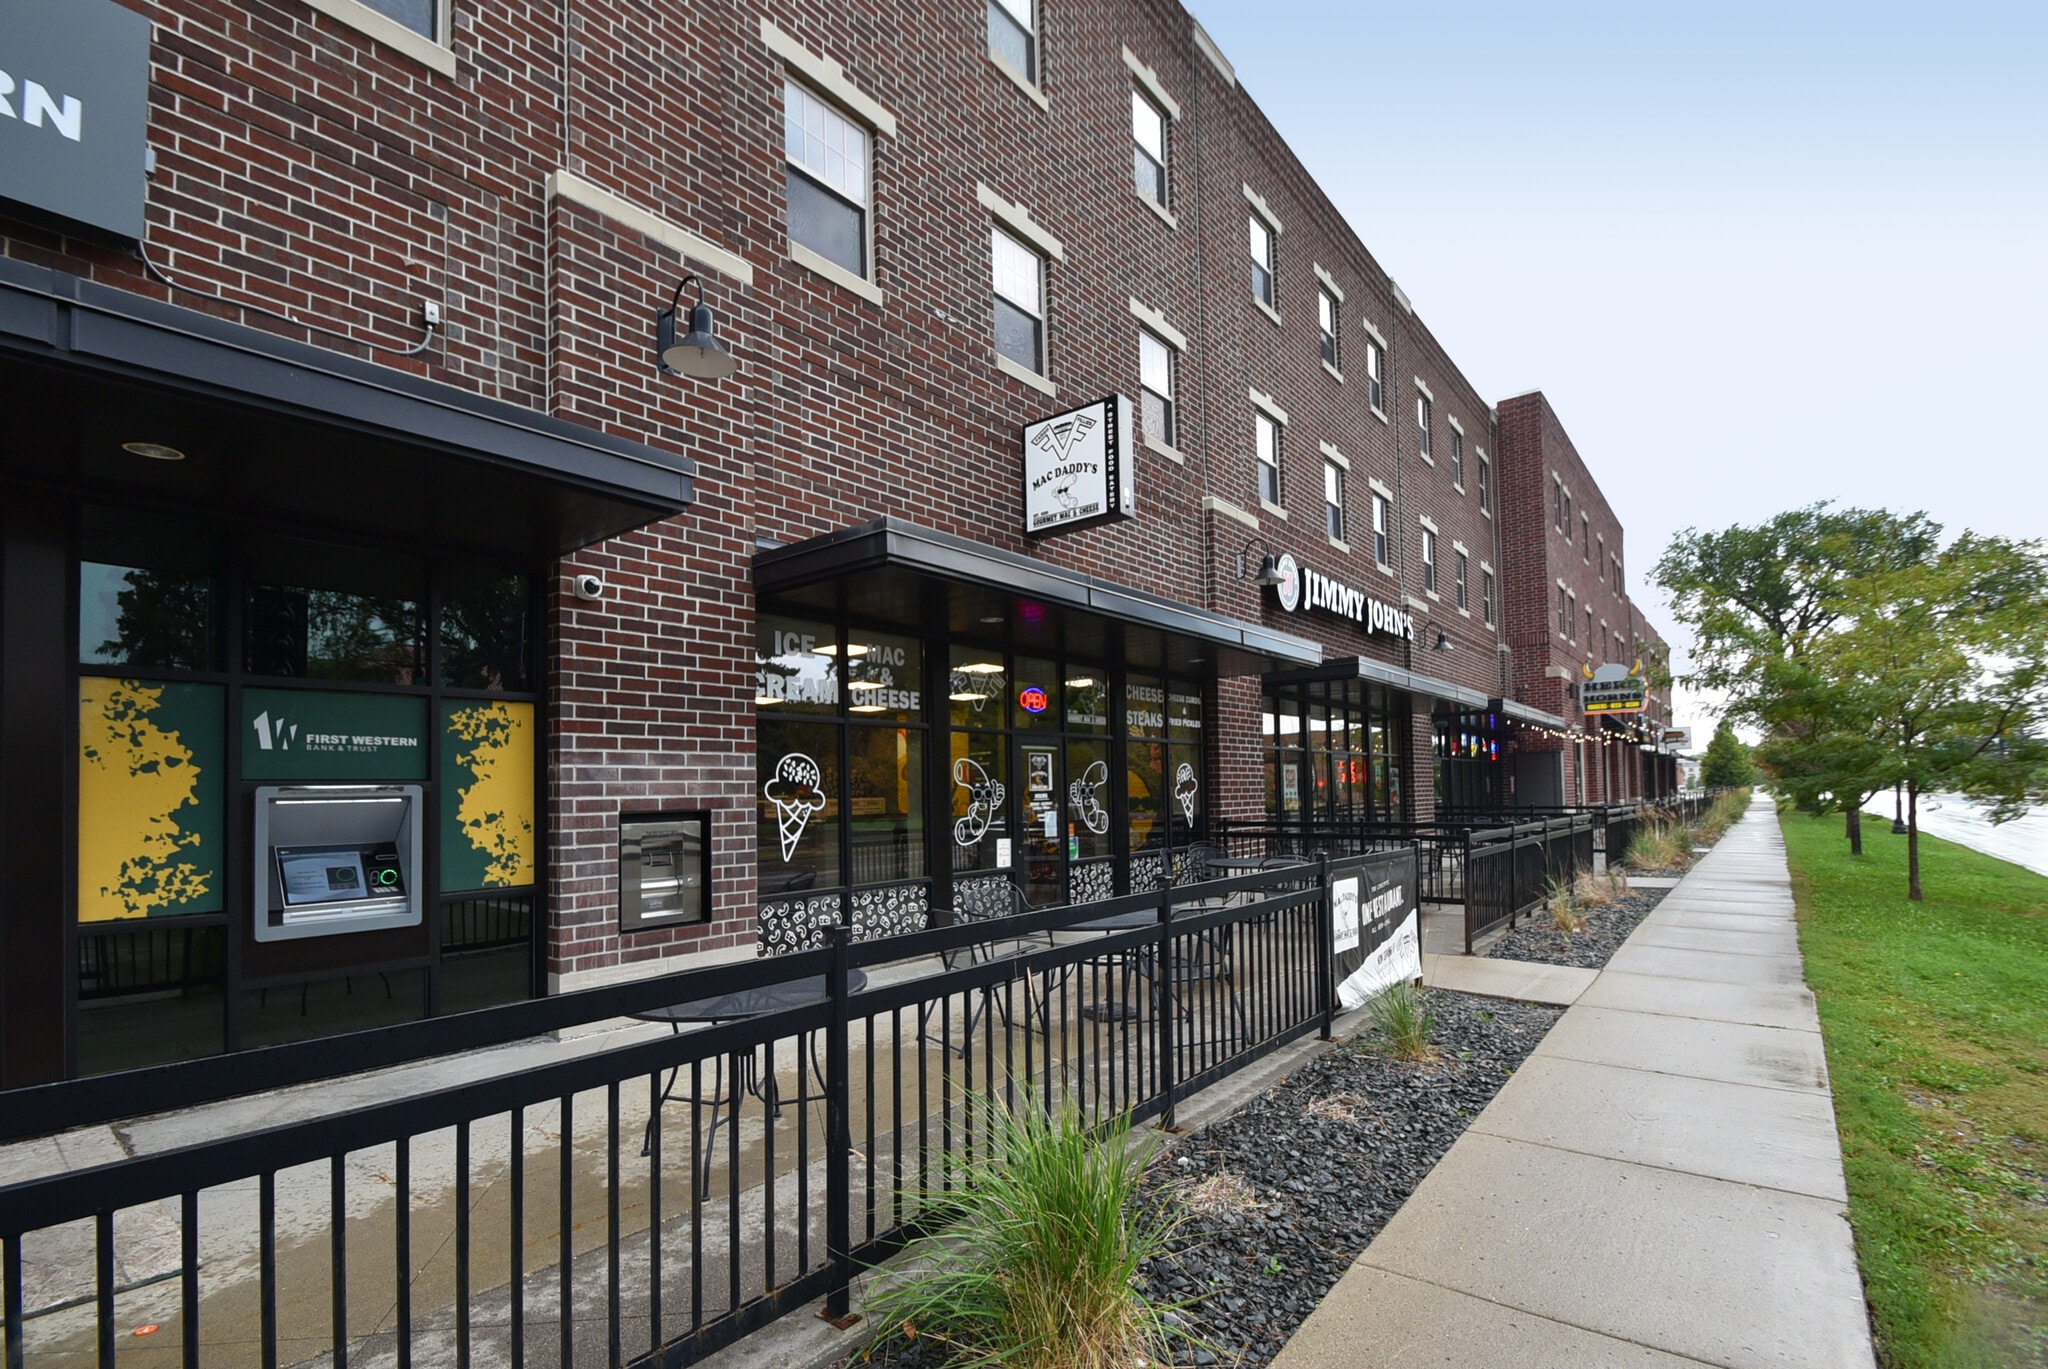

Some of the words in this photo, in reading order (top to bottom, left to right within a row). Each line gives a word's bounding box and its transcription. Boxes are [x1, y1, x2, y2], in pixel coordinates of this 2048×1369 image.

[1032, 471, 1053, 491] MAC
[1055, 462, 1098, 478] DADDY'S
[1059, 510, 1071, 520] MAC
[1079, 502, 1099, 515] CHEESE
[1304, 567, 1364, 622] JIMMY
[1367, 597, 1414, 641] JOHN'S
[774, 630, 816, 659] ICE
[866, 643, 905, 667] MAC
[879, 667, 894, 687] &
[755, 671, 839, 704] CREAM
[1126, 684, 1163, 703] CHEESE
[1583, 691, 1642, 702] HORNS
[851, 687, 921, 710] CHEESE
[1019, 691, 1048, 709] OPEN
[1126, 710, 1164, 728] STEAKS
[306, 733, 348, 745] FIRST
[352, 735, 418, 747] WESTERN
[348, 745, 378, 753] TRUST
